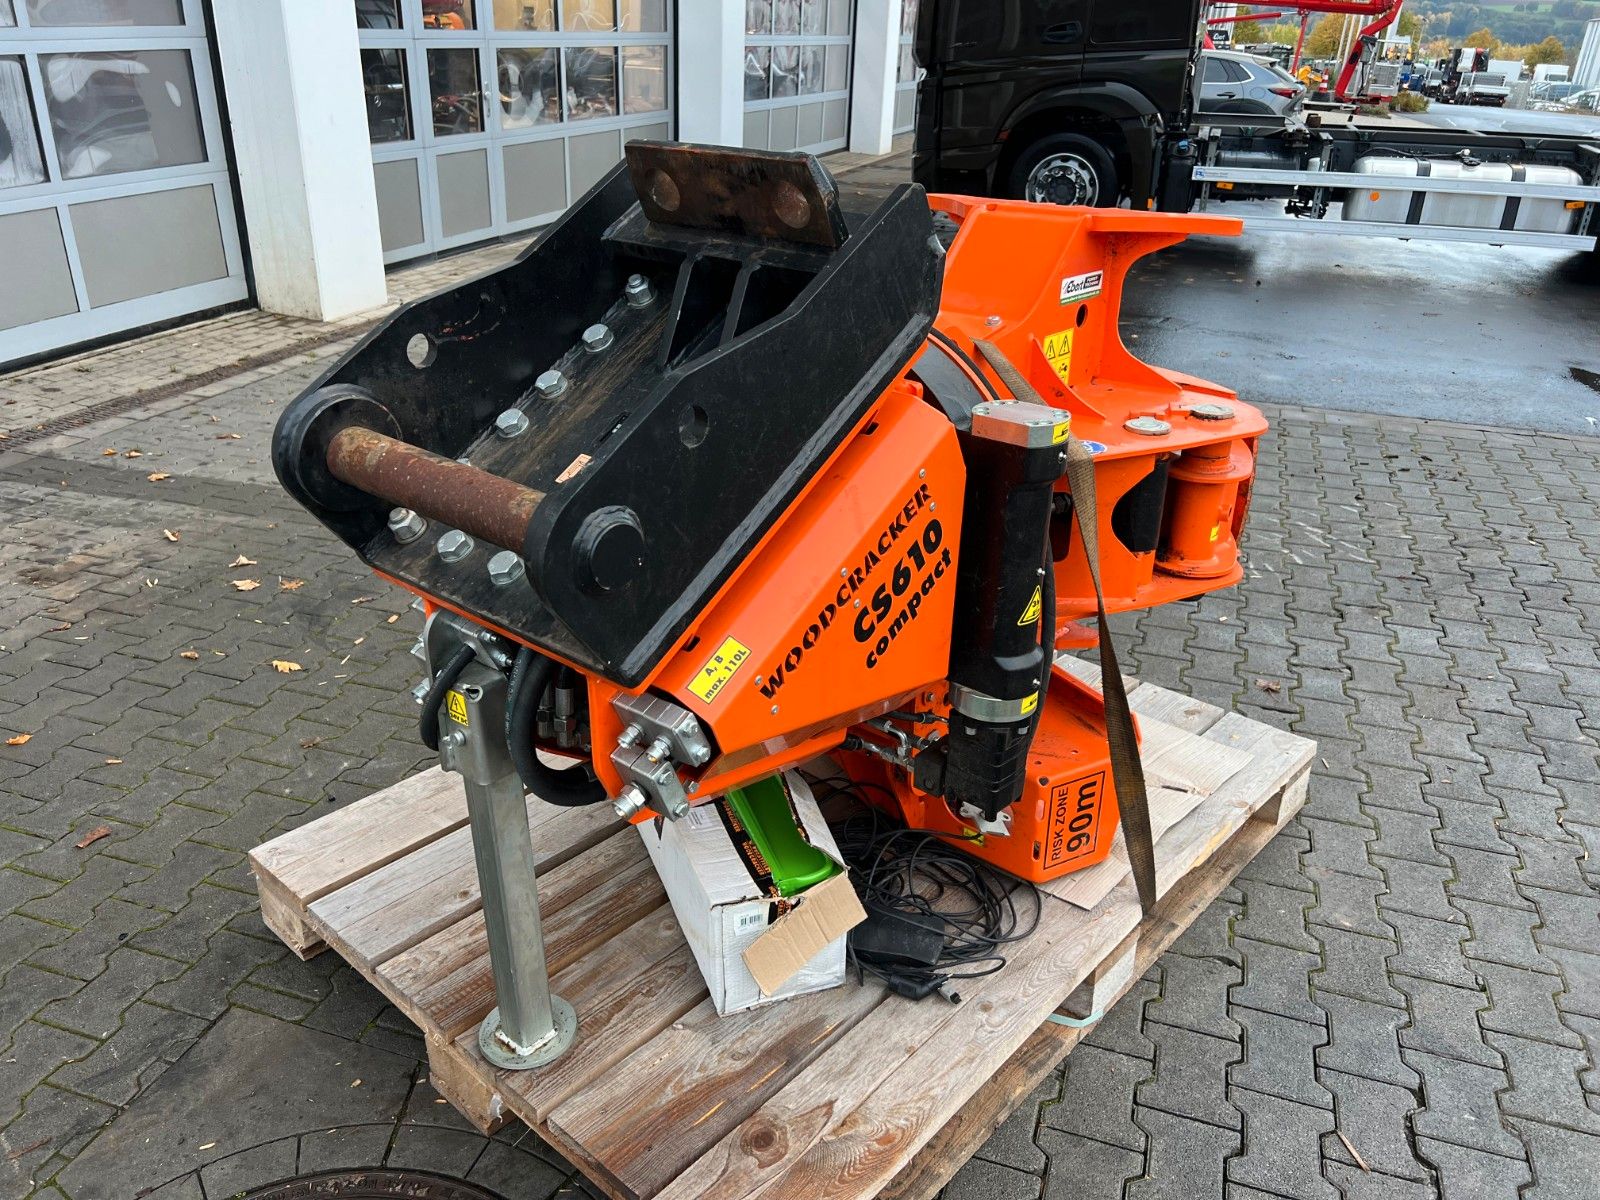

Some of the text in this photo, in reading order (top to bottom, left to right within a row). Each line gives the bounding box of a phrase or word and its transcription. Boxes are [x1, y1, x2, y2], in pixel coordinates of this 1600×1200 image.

[760, 483, 931, 699] WOODCRACKER
[853, 518, 942, 643] CS610
[866, 547, 952, 669] compact
[705, 655, 724, 677] A, B
[705, 650, 747, 699] max. 110L
[1051, 787, 1069, 861] RISK ZONE
[1066, 780, 1097, 852] 90m
